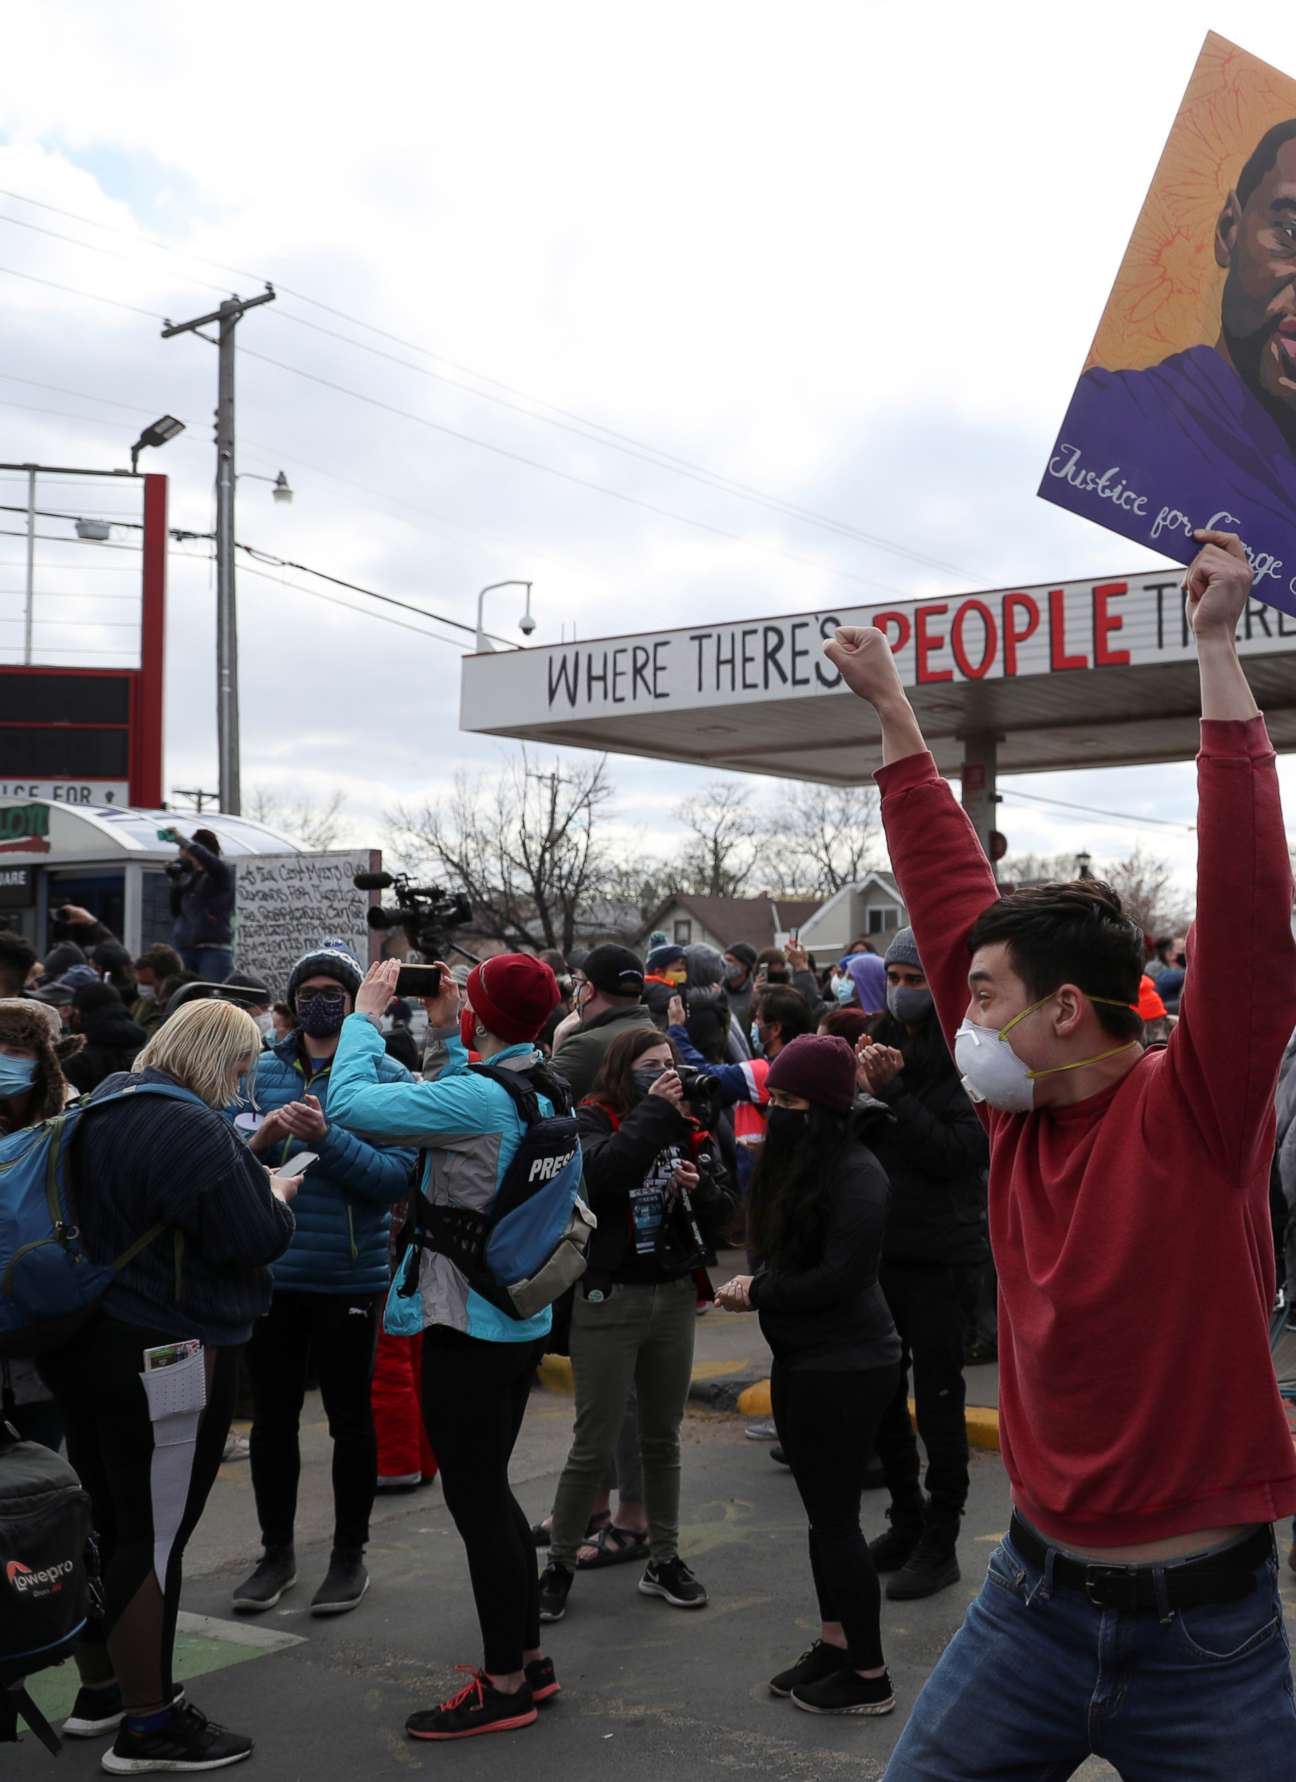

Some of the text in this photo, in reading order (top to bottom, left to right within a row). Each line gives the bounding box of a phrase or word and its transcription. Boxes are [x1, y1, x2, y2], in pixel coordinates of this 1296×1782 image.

[1048, 442, 1149, 516] Justice
[1150, 504, 1196, 539] for
[547, 640, 671, 707] WHERE
[689, 613, 843, 693] THERE'S
[872, 581, 1131, 685] PEOPLE
[53, 785, 92, 805] FOR
